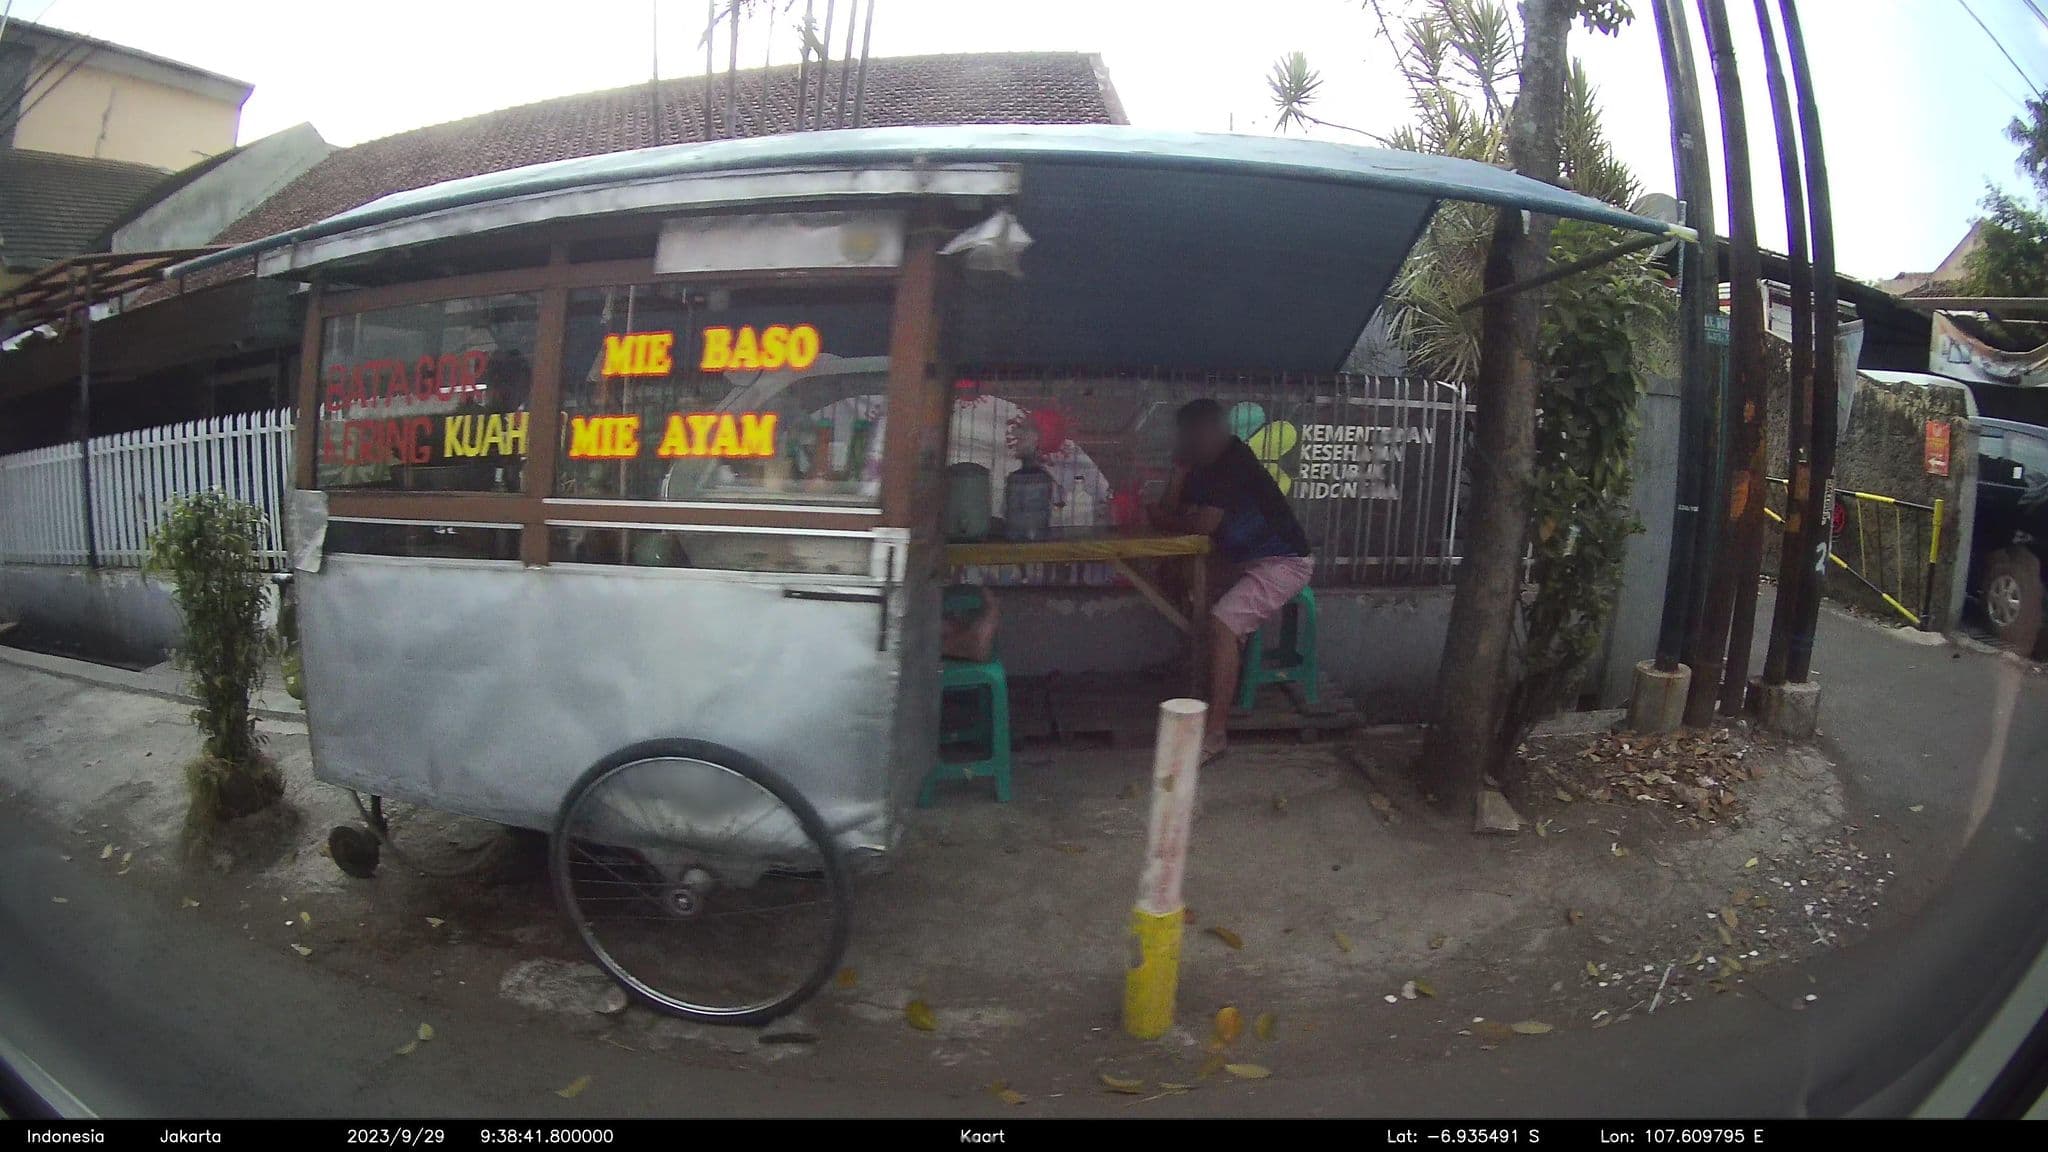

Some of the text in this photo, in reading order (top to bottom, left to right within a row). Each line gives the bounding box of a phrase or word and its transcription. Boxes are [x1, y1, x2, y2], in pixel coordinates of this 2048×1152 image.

[601, 324, 820, 376] MIE BASO
[326, 350, 488, 412] BATAGOR
[443, 411, 530, 458] KUAH
[569, 413, 778, 458] MIE AYAM
[1301, 424, 1434, 444] KEMENTAN
[1300, 444, 1402, 462] KESEHAN
[1299, 463, 1386, 480] REPUB
[1294, 481, 1399, 500] INDON
